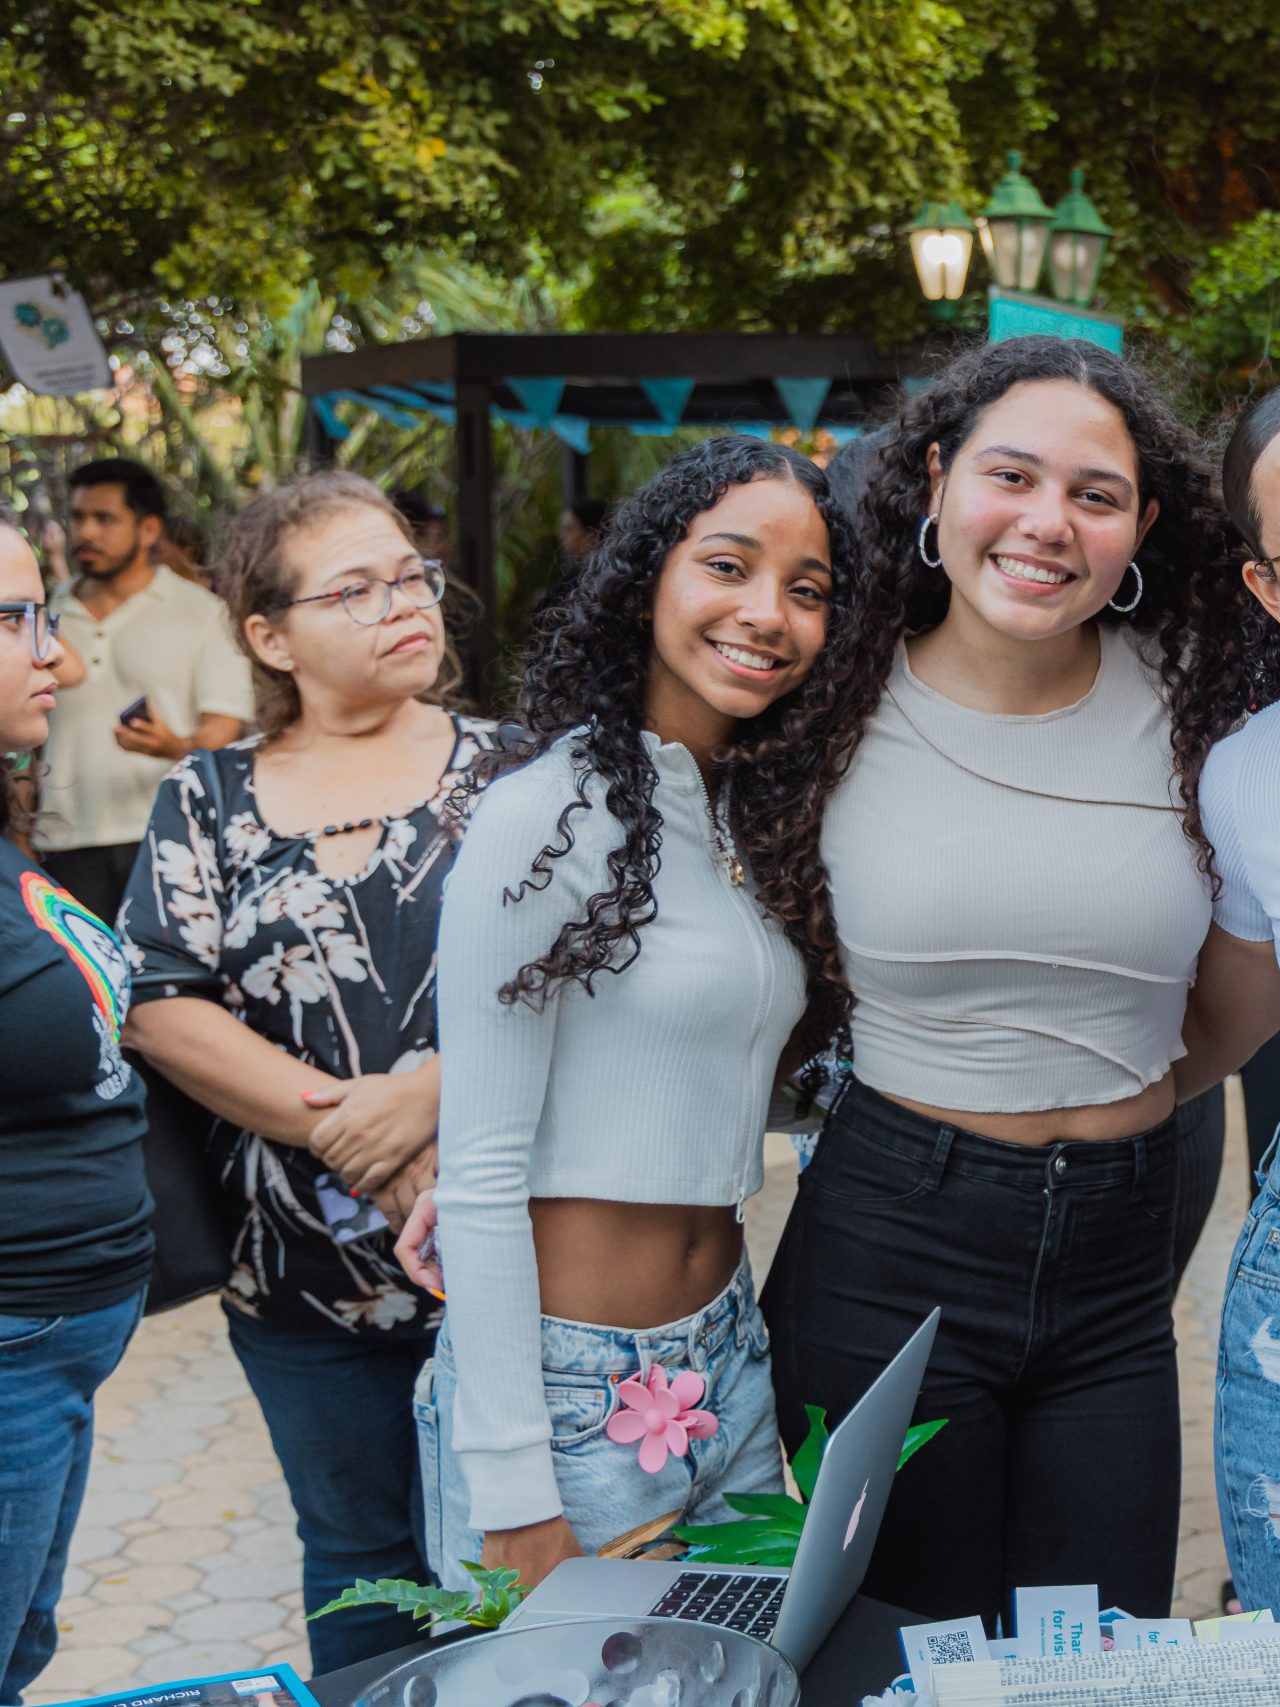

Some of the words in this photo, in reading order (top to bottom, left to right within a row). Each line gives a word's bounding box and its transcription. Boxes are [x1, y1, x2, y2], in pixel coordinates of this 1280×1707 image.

[1053, 1609, 1066, 1630] for
[1148, 1631, 1160, 1644] for
[131, 1689, 200, 1707] RICHARD
